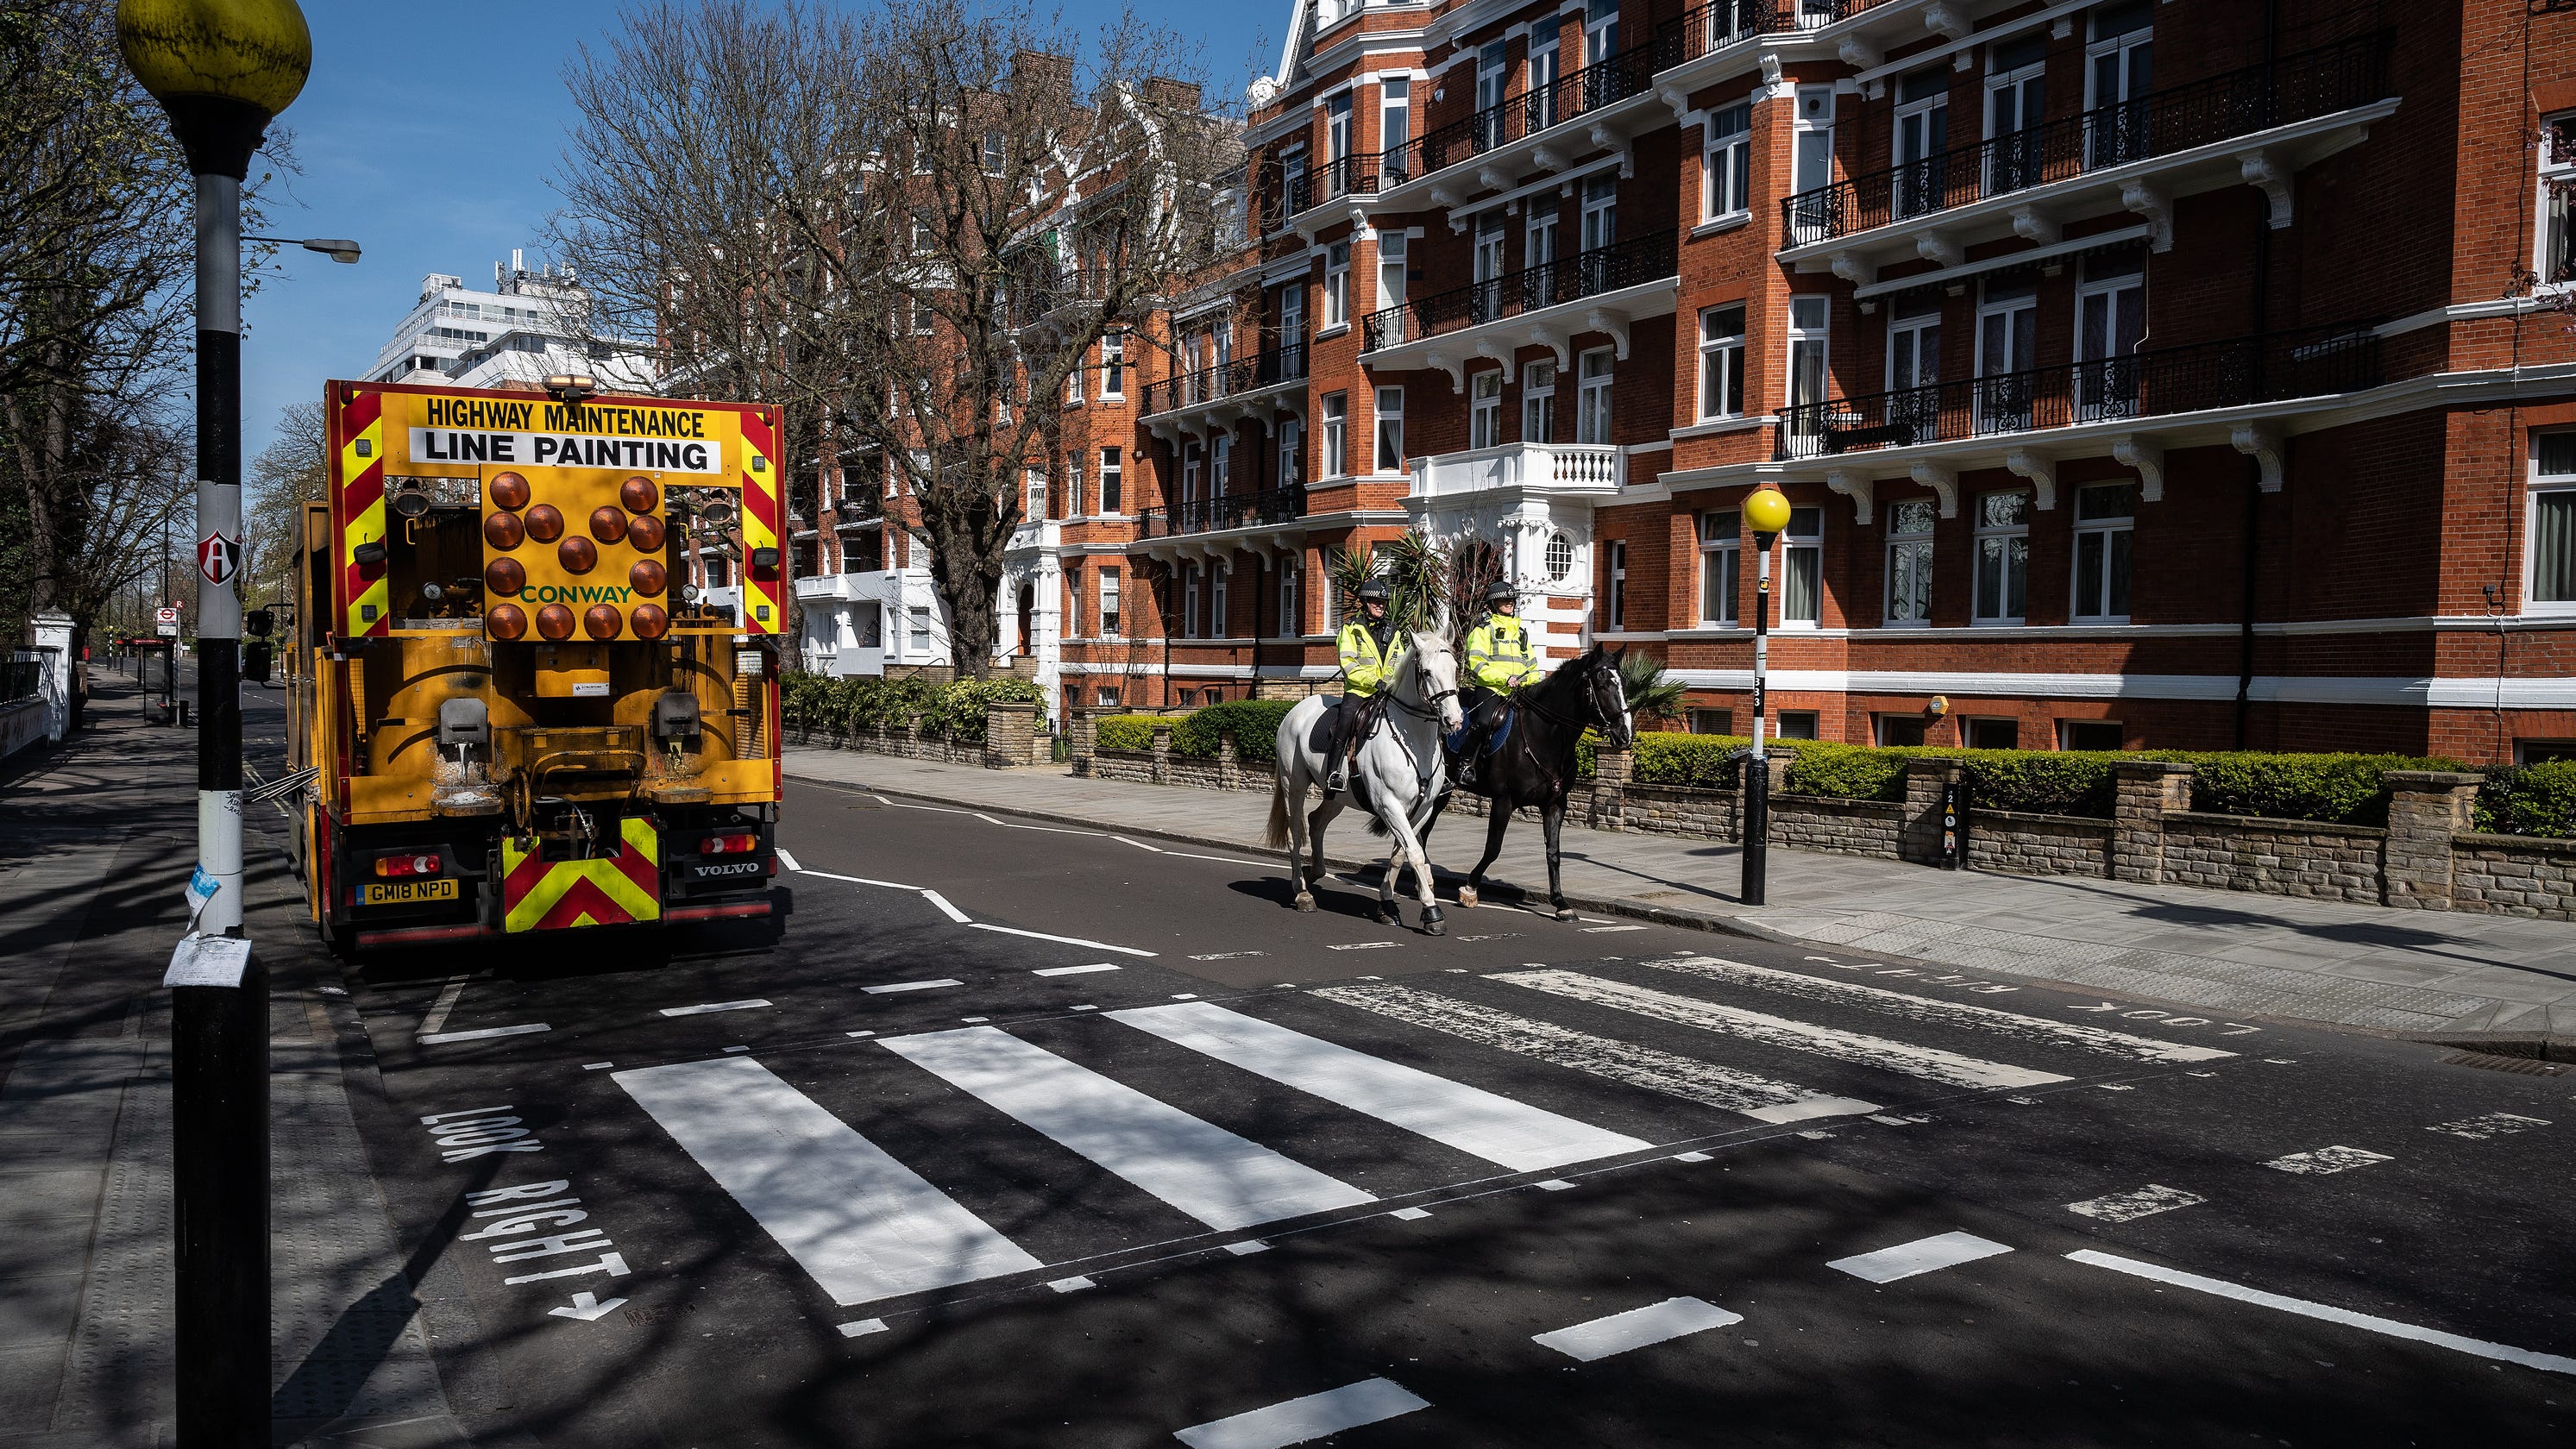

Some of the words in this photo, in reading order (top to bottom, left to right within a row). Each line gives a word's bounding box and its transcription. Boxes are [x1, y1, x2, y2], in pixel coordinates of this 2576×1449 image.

[427, 398, 533, 430] HIGHWAY
[544, 404, 705, 438] MAINTENANCE
[425, 431, 515, 462] LINE
[534, 436, 707, 471] PAINTING
[519, 586, 632, 604] CONWAY
[694, 862, 759, 876] VOLVO
[372, 884, 412, 900] GM18
[418, 881, 451, 898] NPD
[419, 1105, 545, 1164] LOOK
[458, 1179, 631, 1285] RIGHT
